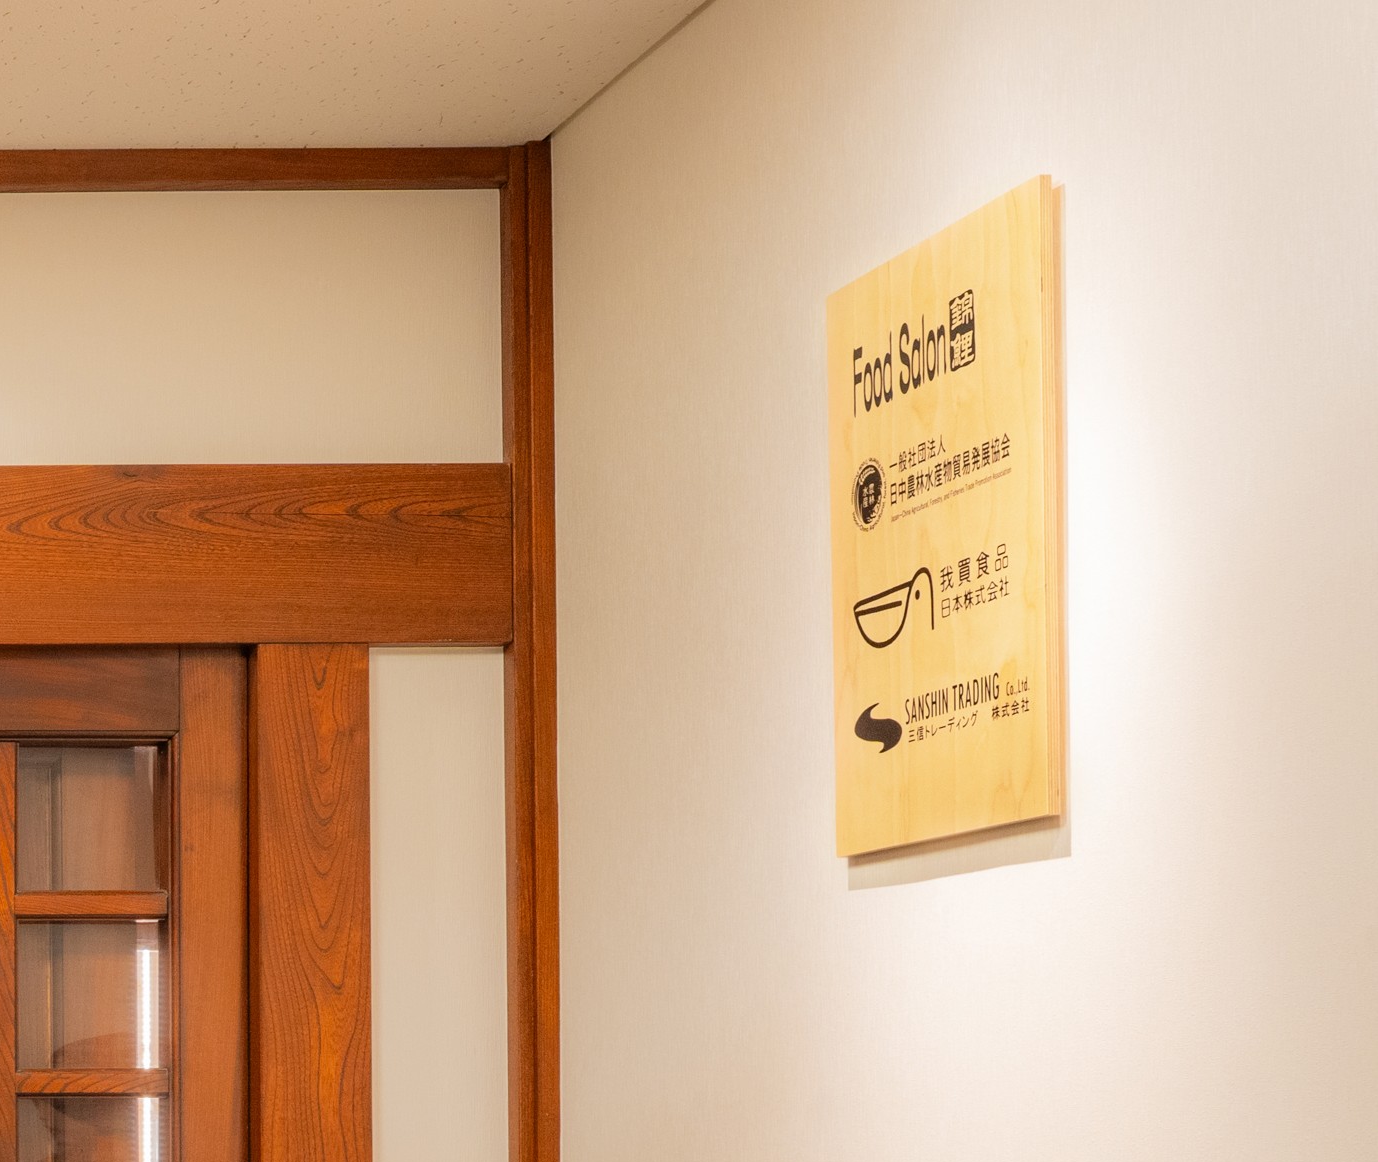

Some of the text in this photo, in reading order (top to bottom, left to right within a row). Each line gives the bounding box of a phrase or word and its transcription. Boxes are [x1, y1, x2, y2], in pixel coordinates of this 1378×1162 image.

[949, 290, 975, 371] 錦鯉
[853, 313, 947, 418] Food Salon
[889, 434, 946, 473] 一般社団法人
[940, 543, 1009, 593] 我買食品
[941, 576, 1010, 619] 日本株式会社
[905, 687, 949, 725] SANSHIN
[952, 672, 1000, 712] TRADING
[908, 697, 1030, 743] 三信トレーディング 株式会社
